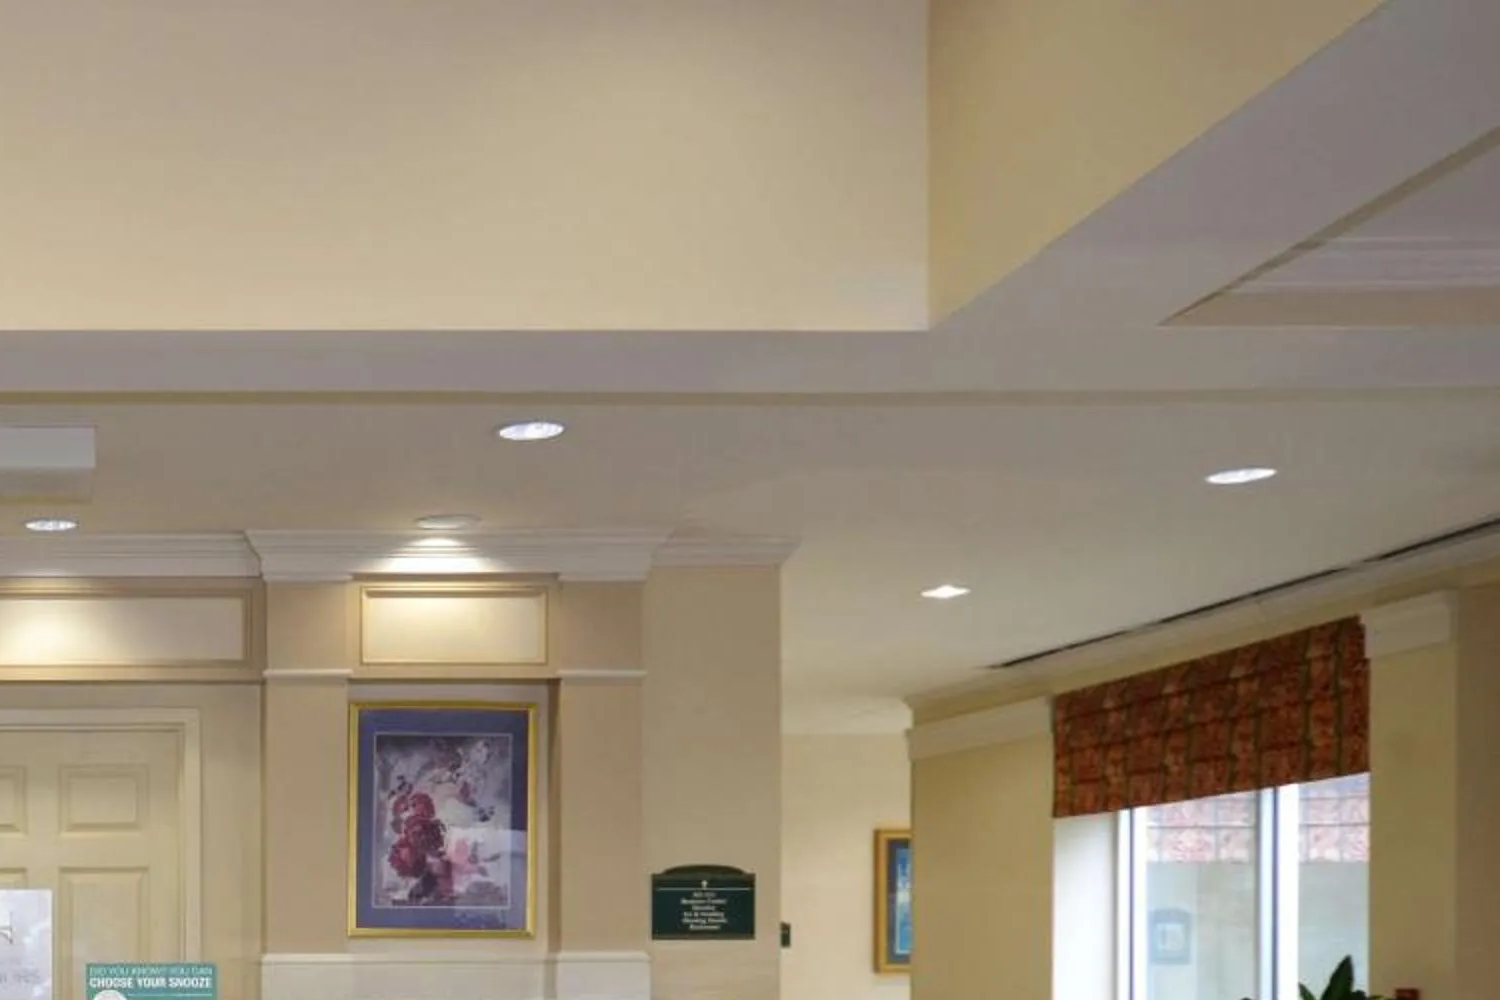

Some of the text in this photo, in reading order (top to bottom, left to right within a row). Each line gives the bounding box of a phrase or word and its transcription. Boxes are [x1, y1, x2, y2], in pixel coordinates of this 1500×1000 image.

[89, 977, 212, 989] CHOOSE YOUR SNOOZE
